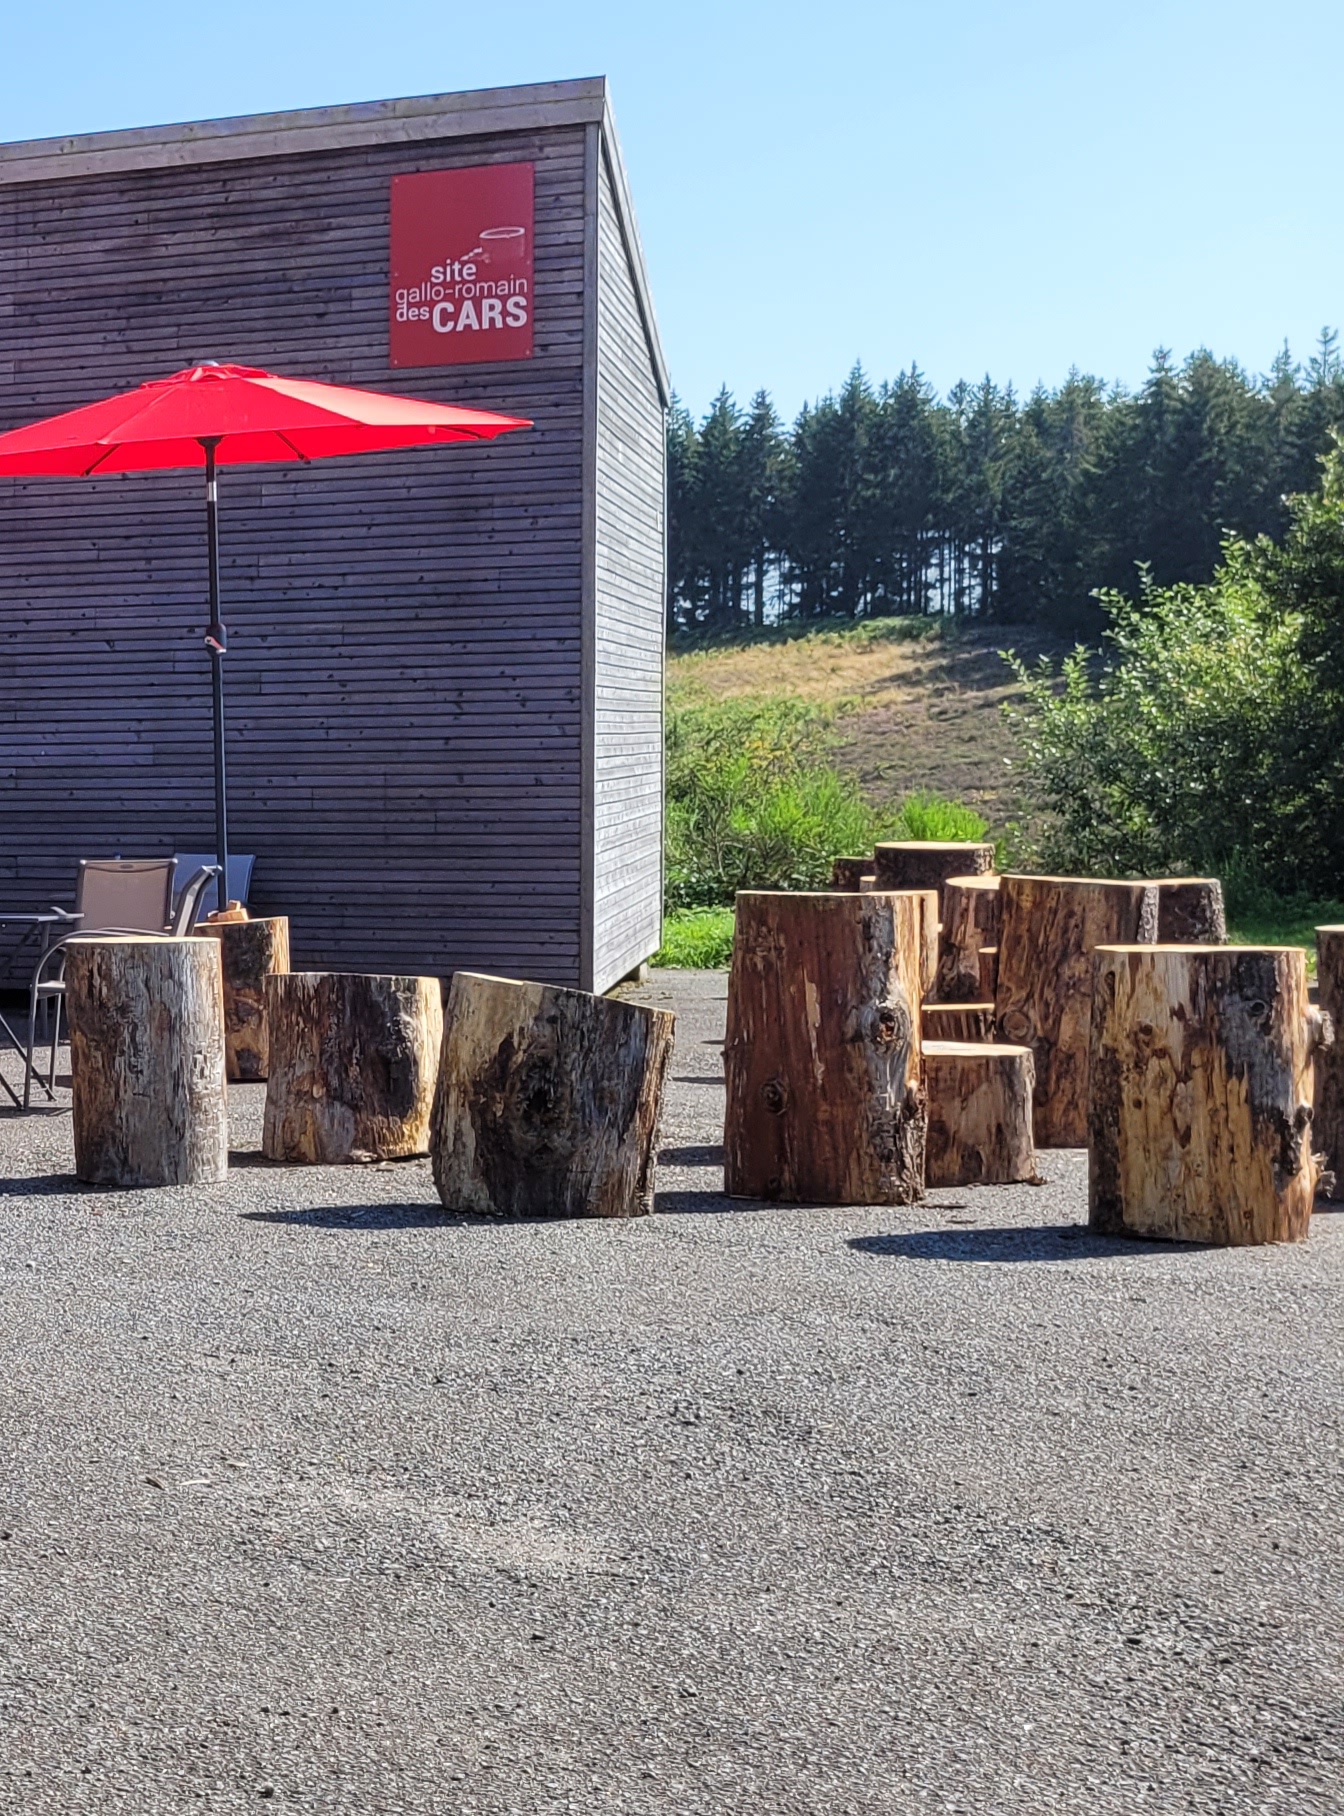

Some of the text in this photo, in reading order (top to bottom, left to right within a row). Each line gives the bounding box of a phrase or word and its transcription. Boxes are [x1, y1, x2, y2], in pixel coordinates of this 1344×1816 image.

[430, 258, 477, 283] site
[395, 274, 528, 304] gallo-romain
[396, 295, 528, 333] des CARS
